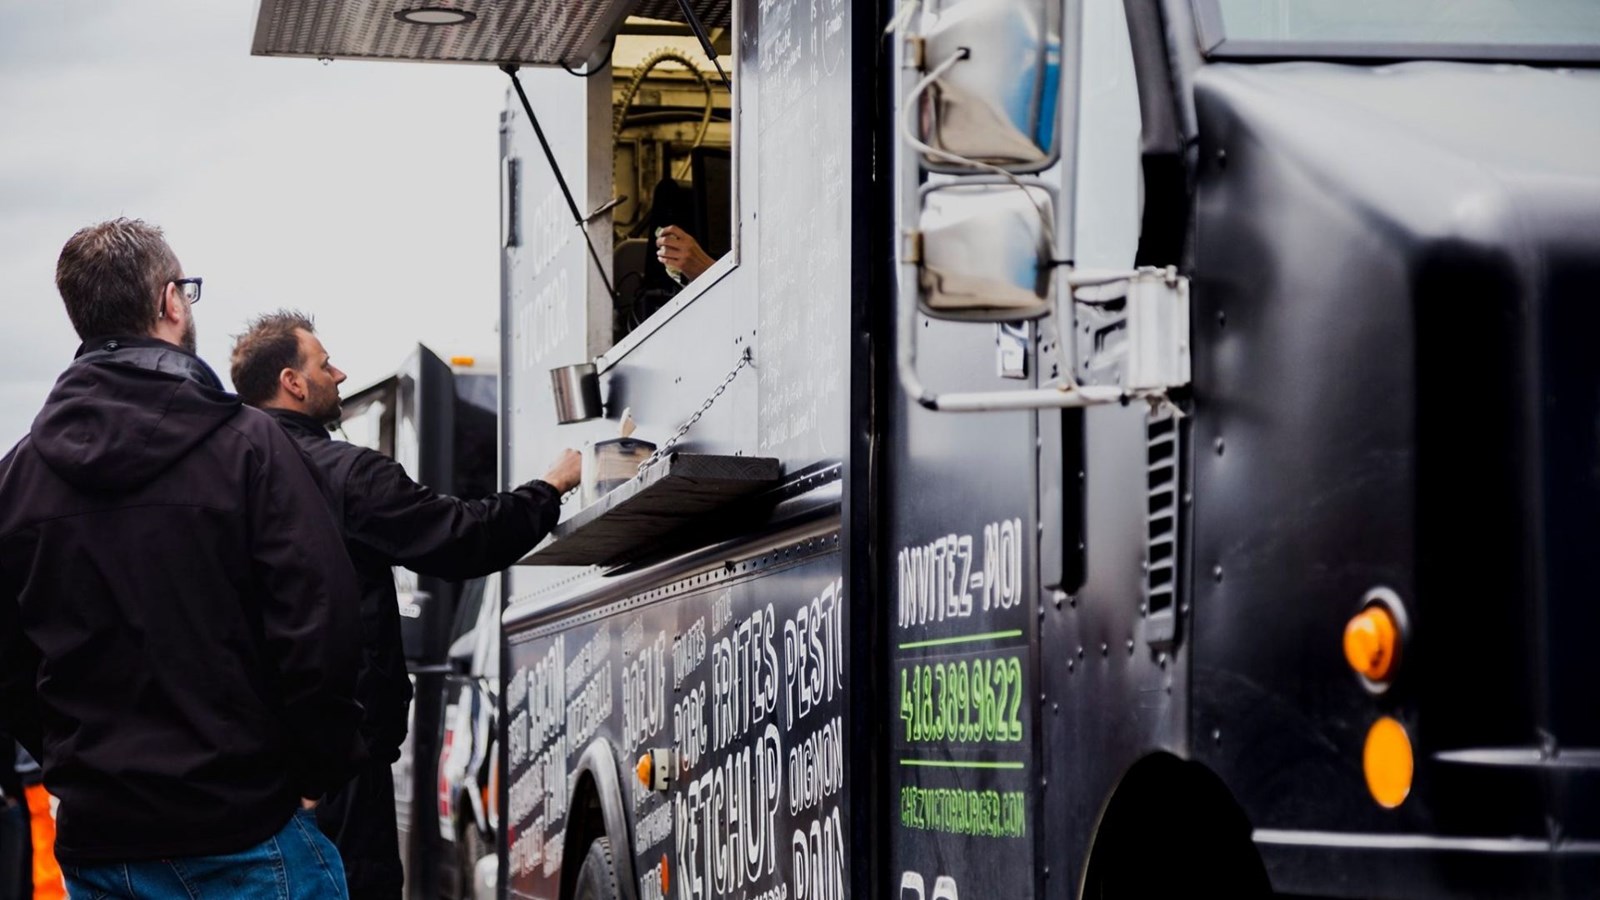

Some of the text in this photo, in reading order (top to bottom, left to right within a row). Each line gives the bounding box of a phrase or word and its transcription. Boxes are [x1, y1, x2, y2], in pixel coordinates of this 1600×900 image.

[520, 268, 569, 371] VICTOR
[898, 518, 1022, 629] INVITEZ-MOI
[622, 630, 666, 762] BOEUF
[672, 616, 706, 691] TOMATES
[712, 602, 778, 752] FRITES
[900, 657, 1023, 743] 418.389.9622
[674, 680, 708, 782] PORC
[789, 716, 843, 816] OIGNON
[675, 723, 782, 900] KETCHUP
[901, 786, 1026, 838] CHEZVICTORBURGER.COM
